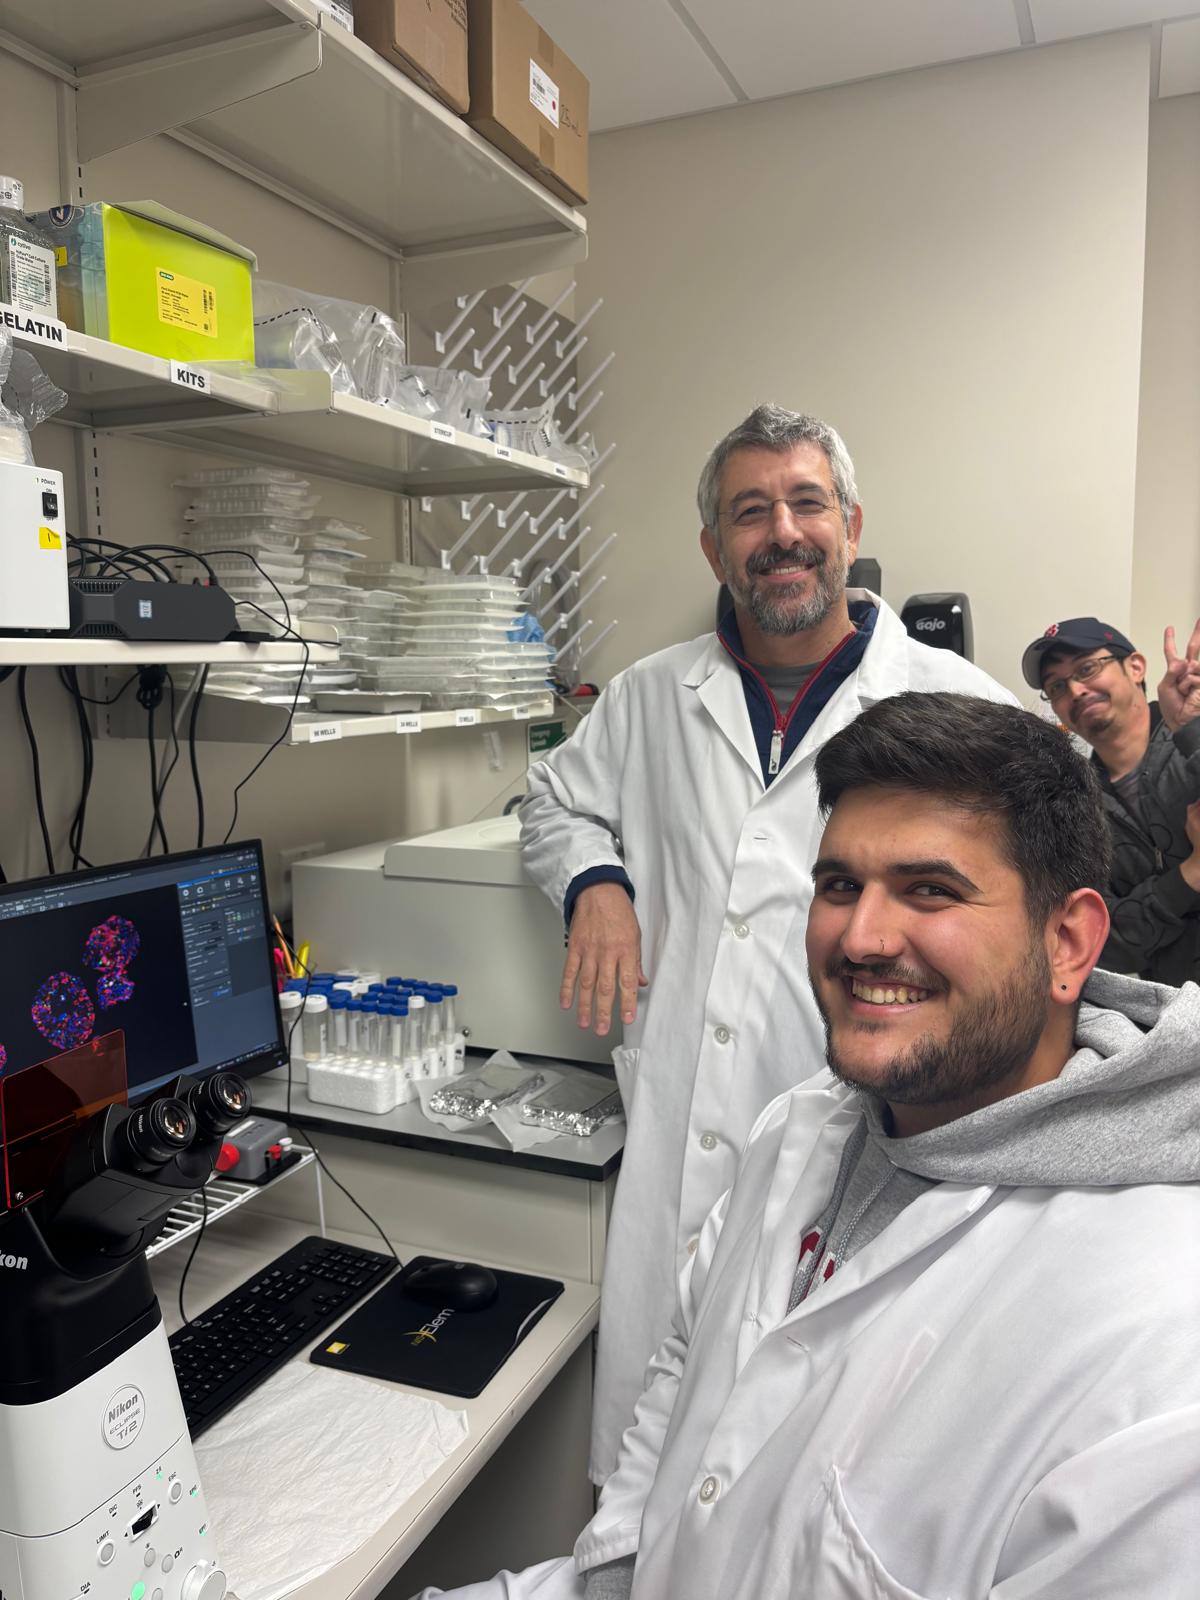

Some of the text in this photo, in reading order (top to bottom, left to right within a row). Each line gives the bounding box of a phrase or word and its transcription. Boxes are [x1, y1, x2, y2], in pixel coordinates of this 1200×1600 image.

[177, 368, 206, 389] KITS
[41, 478, 56, 486] POWER
[320, 728, 336, 736] WELLS
[108, 1394, 138, 1424] Nikon
[109, 1408, 141, 1435] ECLIPSE
[108, 1504, 118, 1514] DIC
[96, 1530, 110, 1544] LIMIT
[80, 1581, 91, 1592] DIA
